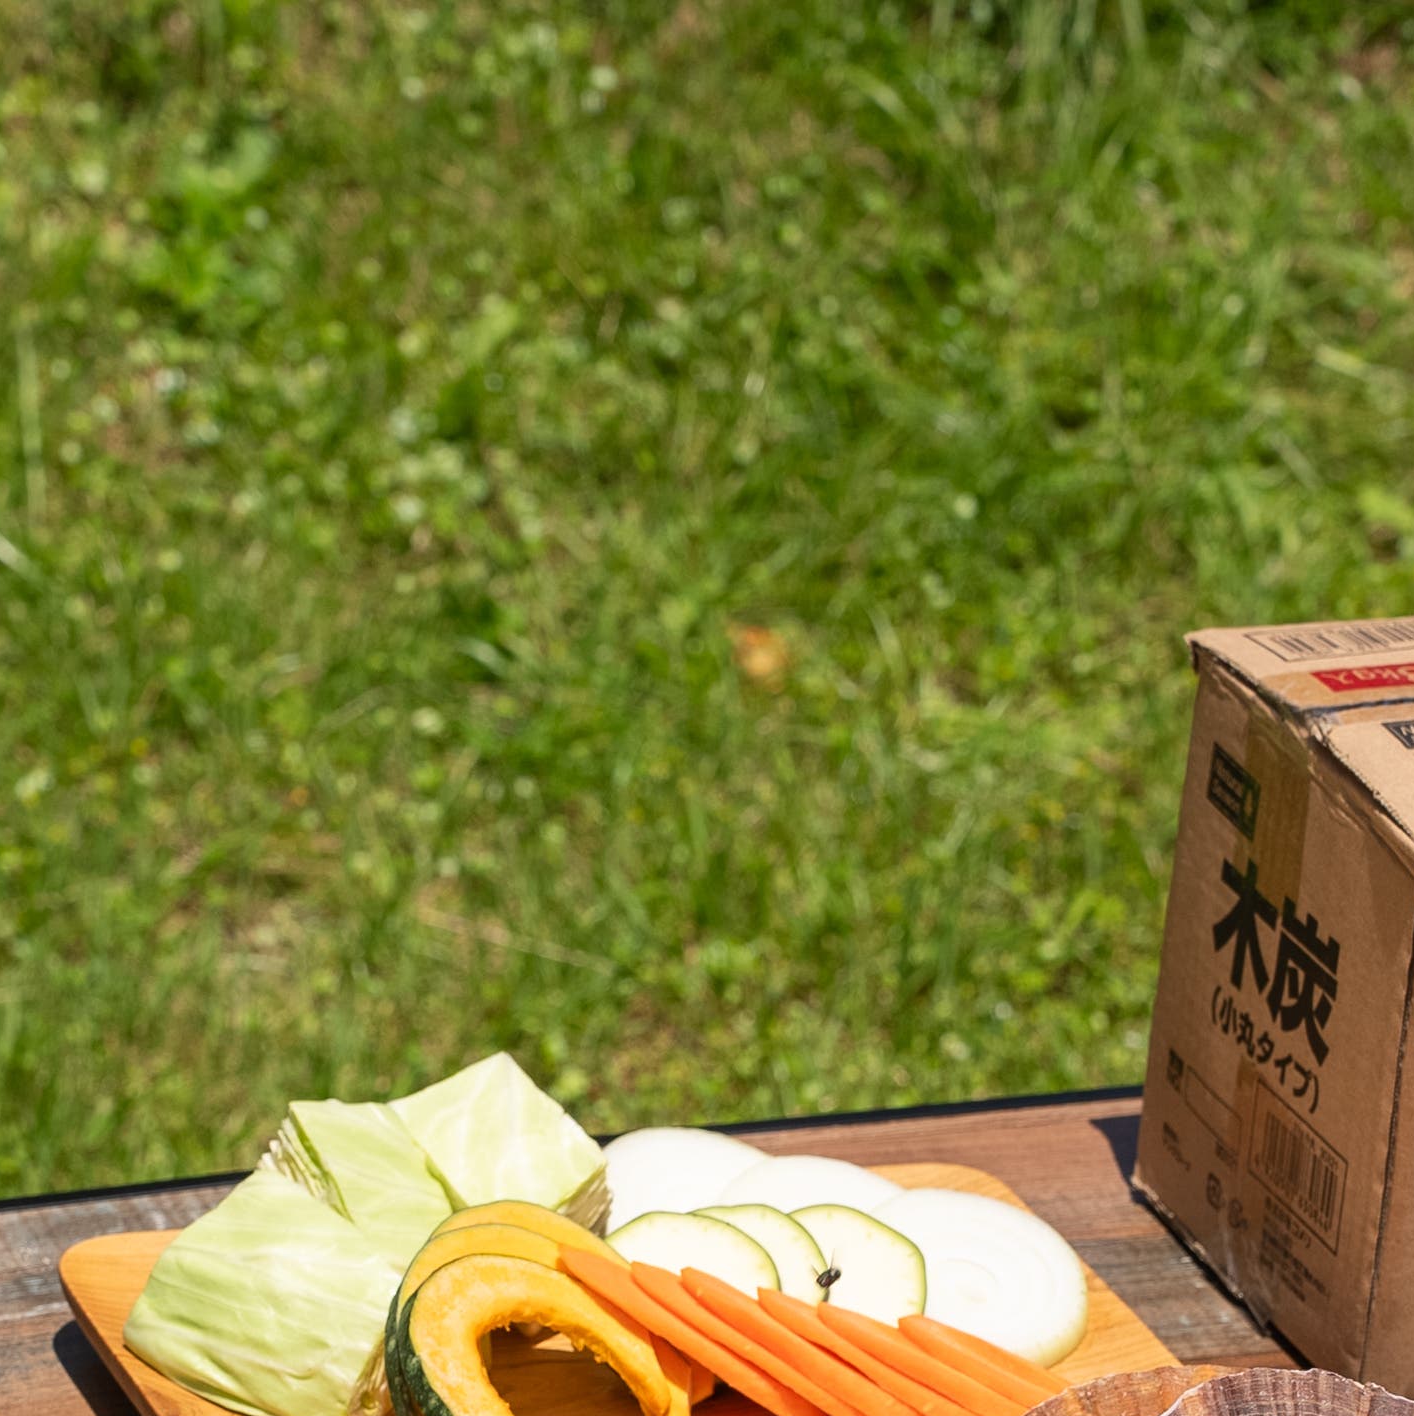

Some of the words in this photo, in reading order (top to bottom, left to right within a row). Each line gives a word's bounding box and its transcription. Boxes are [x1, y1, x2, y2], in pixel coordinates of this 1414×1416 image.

[1212, 858, 1341, 1067] 木炭
[1211, 985, 1320, 1115] （小丸タイプ）
